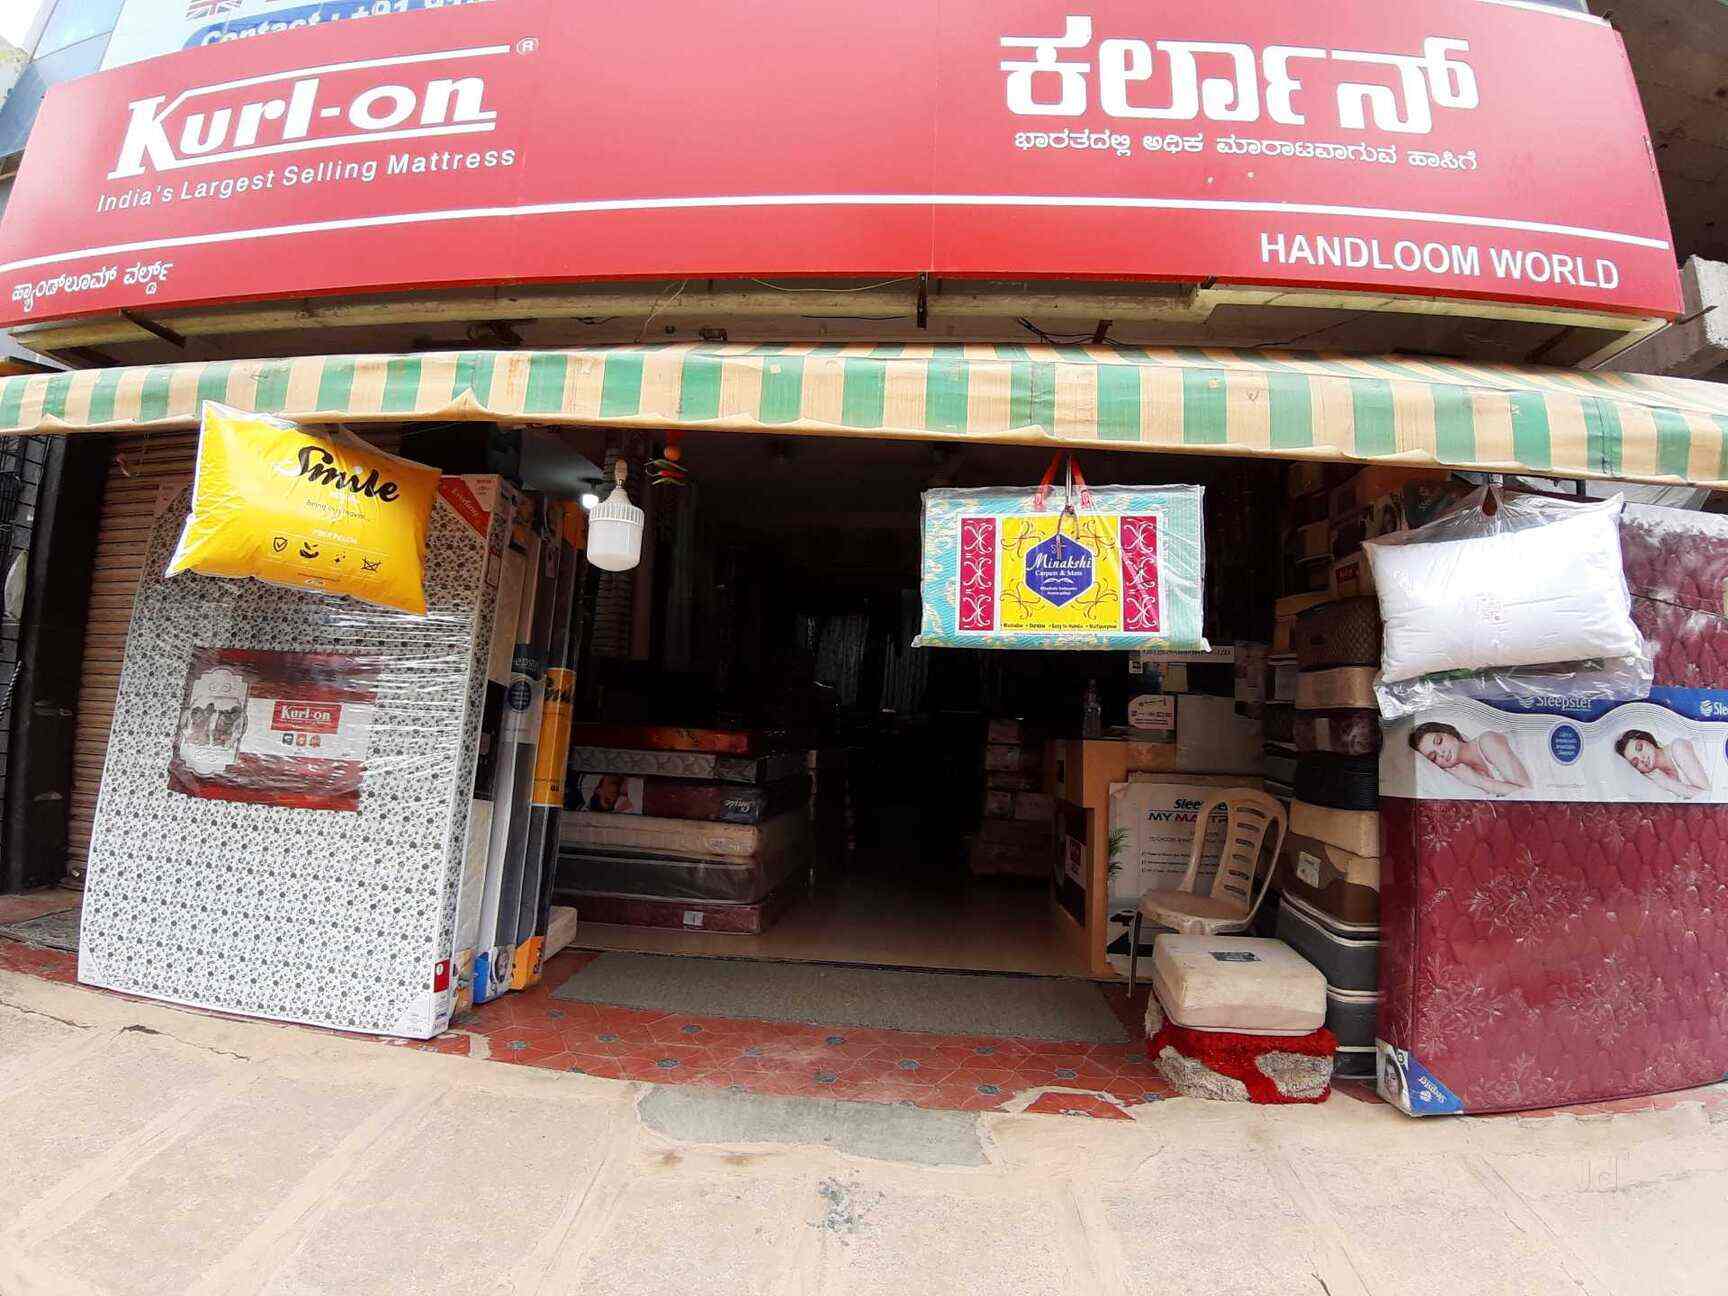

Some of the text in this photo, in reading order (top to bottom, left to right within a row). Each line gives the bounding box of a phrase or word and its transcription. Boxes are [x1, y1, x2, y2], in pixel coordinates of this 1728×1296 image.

[107, 74, 498, 181] Kurl-on
[1014, 129, 1131, 157] ಭಾರತದಲ್ಲಿ
[1142, 132, 1205, 155] ಅಧಿಕ
[96, 148, 516, 213] India's Largest Selling Mattress
[1260, 232, 1620, 289] HANDLOOM WORLD
[297, 446, 400, 502] Smile
[1027, 552, 1093, 571] Minakshi
[280, 704, 331, 722] Kurl-on
